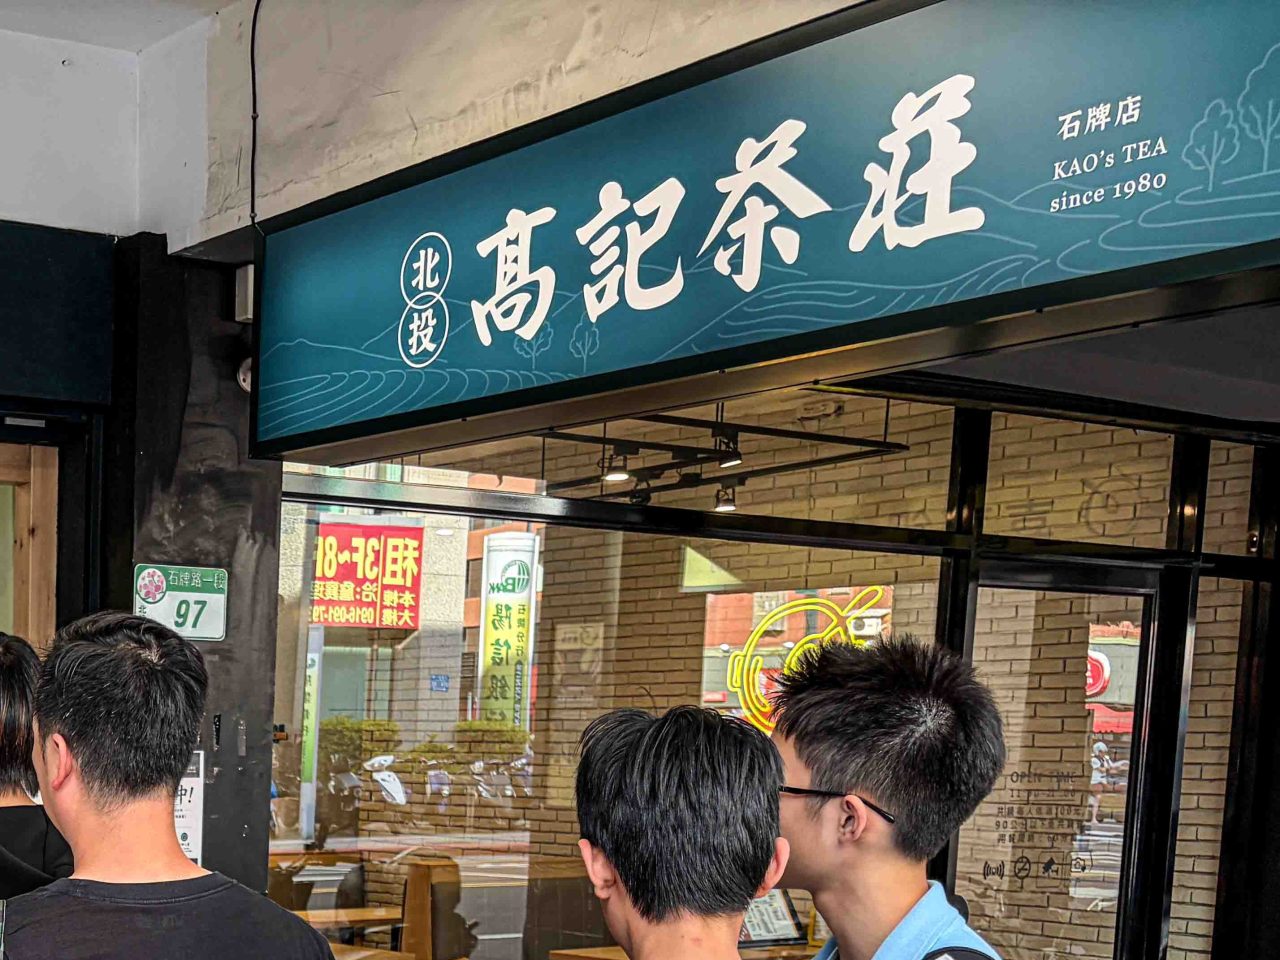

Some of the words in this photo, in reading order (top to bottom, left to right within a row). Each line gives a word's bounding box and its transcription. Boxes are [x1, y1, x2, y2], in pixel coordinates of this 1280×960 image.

[1057, 96, 1141, 140] 石牌店
[1053, 150, 1114, 181] KAO's
[1122, 136, 1167, 163] TEA
[471, 74, 985, 347] 高記茶莊
[1050, 188, 1105, 213] since
[1113, 173, 1166, 199] 1980
[408, 248, 440, 355] 北投
[168, 571, 224, 589] 石牌路一段
[174, 600, 208, 628] 97
